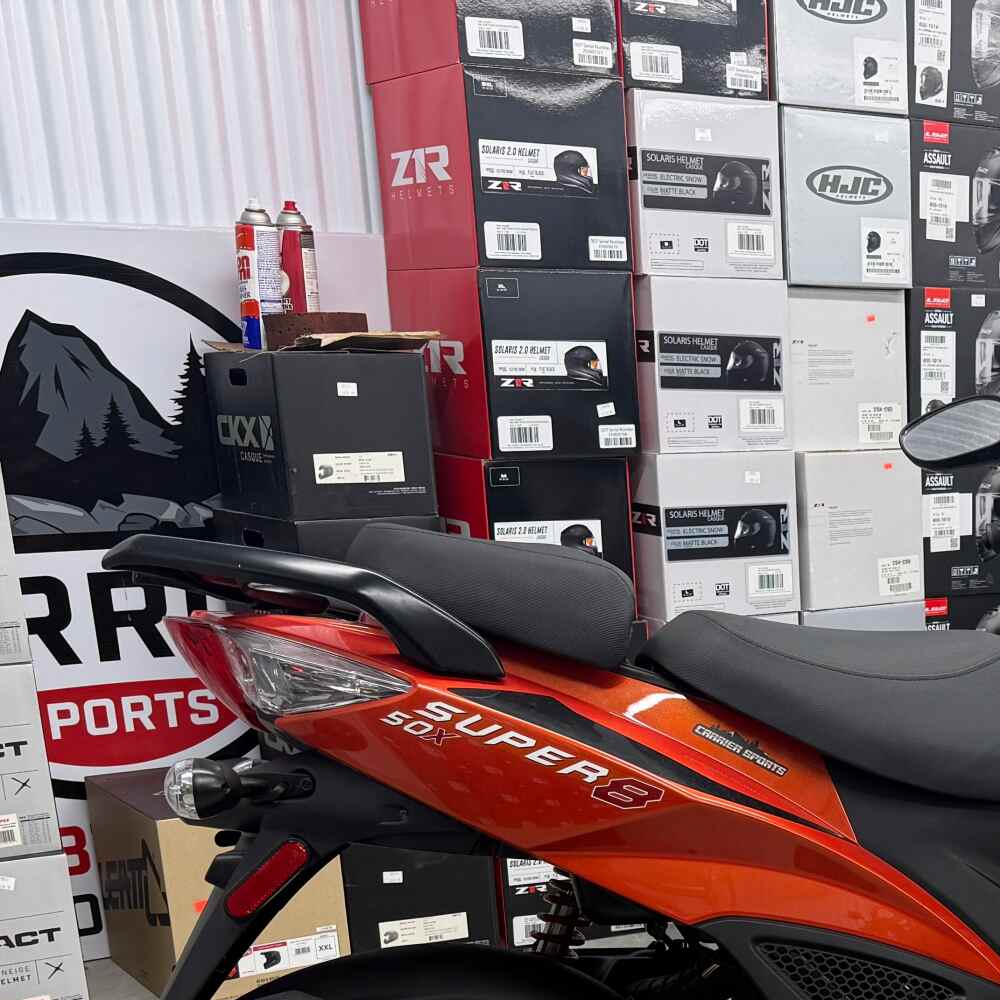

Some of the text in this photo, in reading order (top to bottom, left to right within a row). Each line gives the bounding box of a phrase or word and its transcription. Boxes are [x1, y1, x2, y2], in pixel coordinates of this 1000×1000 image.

[481, 145, 540, 158] SOLARIS 2.0 HELMET
[646, 153, 704, 165] SOLARIS HELMET
[923, 152, 952, 166] ASSAULT
[818, 174, 882, 196] HJC
[391, 184, 456, 201] HELMETS
[924, 312, 954, 325] ASSAULT
[663, 336, 719, 346] SOLARIS HELMET
[494, 345, 552, 355] SOLARIS 2.0 HELMET
[240, 450, 264, 464] CASQUE
[925, 475, 954, 488] ASSAULT
[669, 508, 725, 520] SOLARIS HELMET
[497, 525, 548, 536] SOLARIS 2.0 HELMET
[47, 688, 220, 740] PORTS
[379, 710, 462, 746] 50X
[412, 701, 609, 784] SUPER
[694, 725, 788, 776] CARRIER SPORTS
[318, 944, 333, 952] XXL
